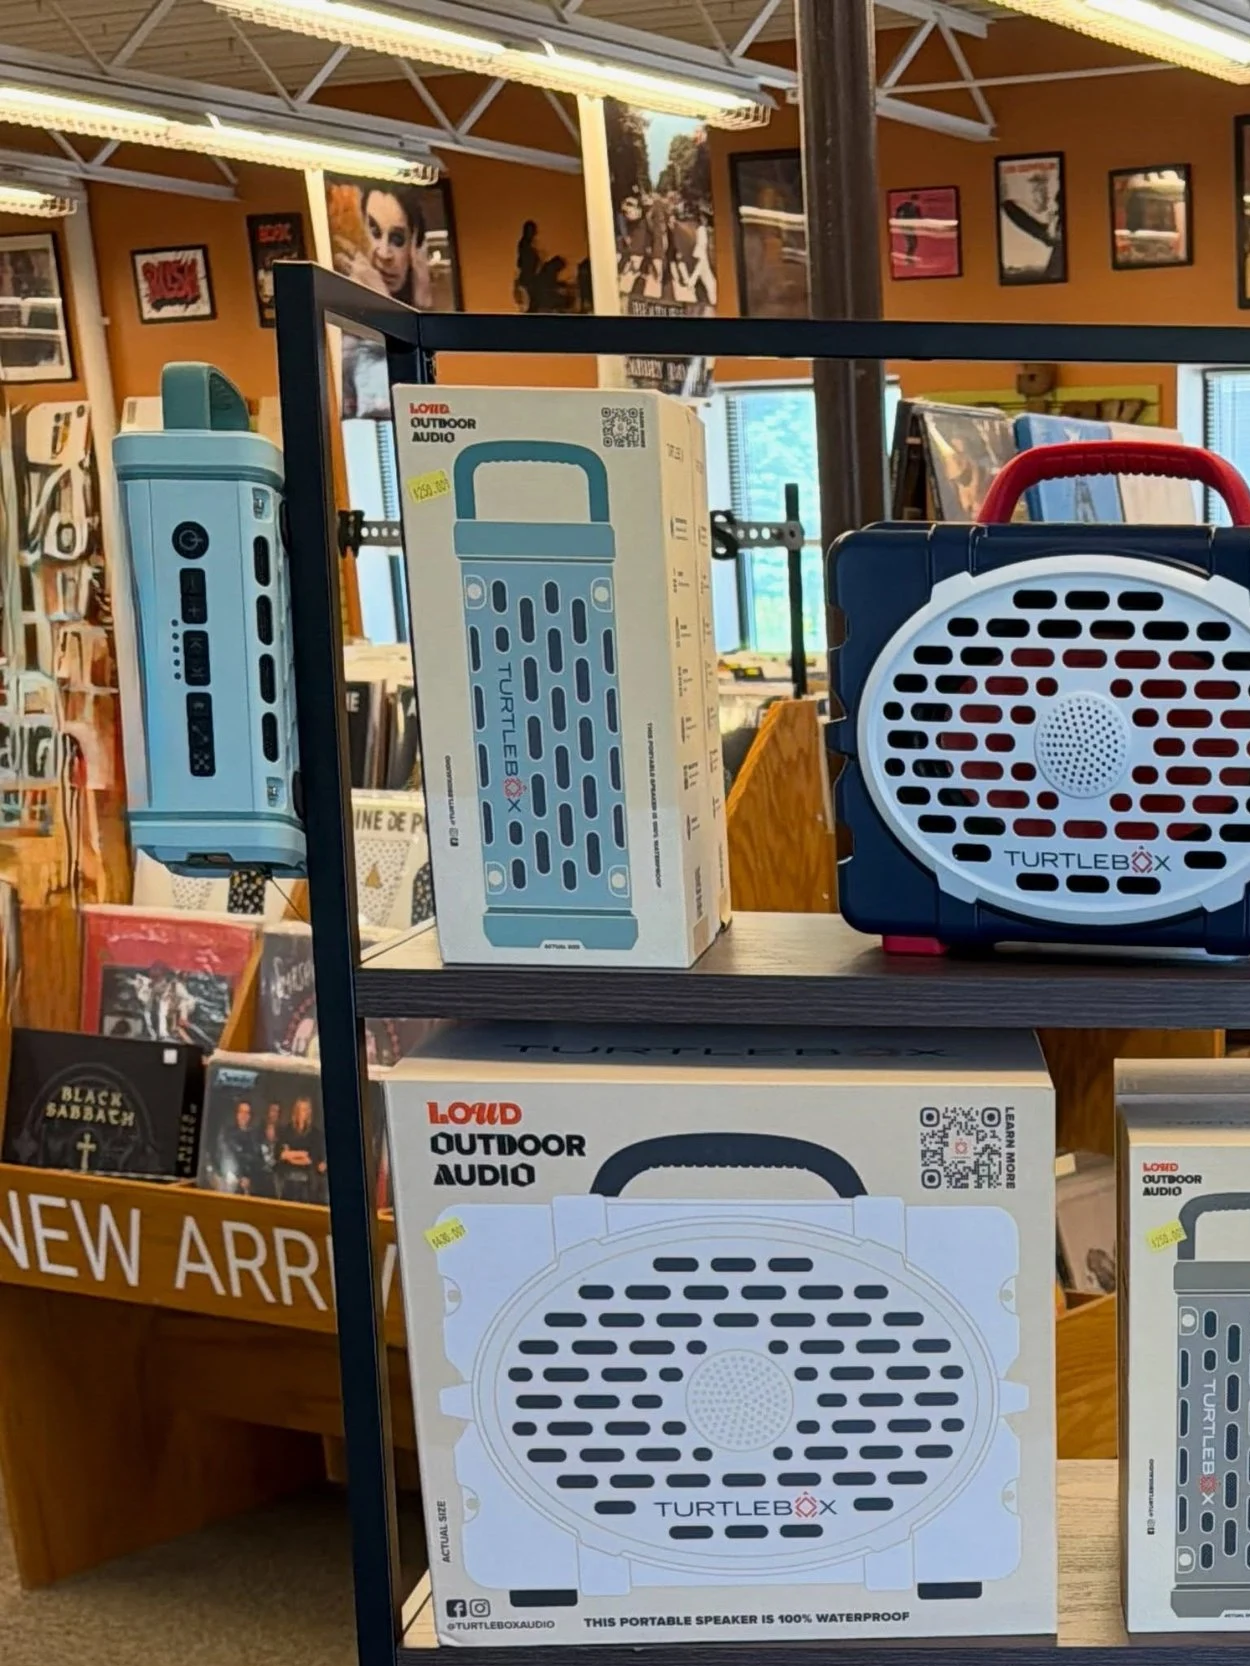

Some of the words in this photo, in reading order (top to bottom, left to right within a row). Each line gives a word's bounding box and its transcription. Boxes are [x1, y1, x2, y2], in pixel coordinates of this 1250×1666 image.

[409, 403, 450, 415] LOUD
[411, 418, 476, 430] OUTDOOR
[412, 432, 455, 443] AUDIO
[498, 662, 526, 813] TURTLEBOX
[1004, 845, 1171, 874] TURTLEBOX
[61, 1086, 124, 1108] BLACK
[45, 1102, 135, 1128] SABBATH
[426, 1101, 522, 1125] LOUD
[1004, 1106, 1015, 1149] LEARN
[430, 1131, 587, 1158] OUTDOOR
[433, 1161, 536, 1187] AUDIO
[1005, 1151, 1015, 1190] MORE
[1142, 1162, 1179, 1172] LOUD
[1142, 1174, 1202, 1185] OUTDOOR
[1142, 1186, 1182, 1197] AUDIO
[0, 1190, 140, 1287] NEW
[175, 1215, 337, 1311] ARR
[1200, 1379, 1221, 1505] TURTLEBOX
[438, 1500, 448, 1524] SIZE
[653, 1491, 838, 1520] TURTLEBOX
[442, 1525, 451, 1563] ACTUAL
[447, 1619, 555, 1631] @TURTLEBOXAUDIO
[584, 1617, 616, 1628] THIS
[619, 1616, 692, 1627] PORTABLE
[695, 1614, 759, 1627] SPEAKER
[761, 1614, 775, 1625] IS
[778, 1613, 812, 1625] 100%
[816, 1611, 911, 1624] WATERPROOF
